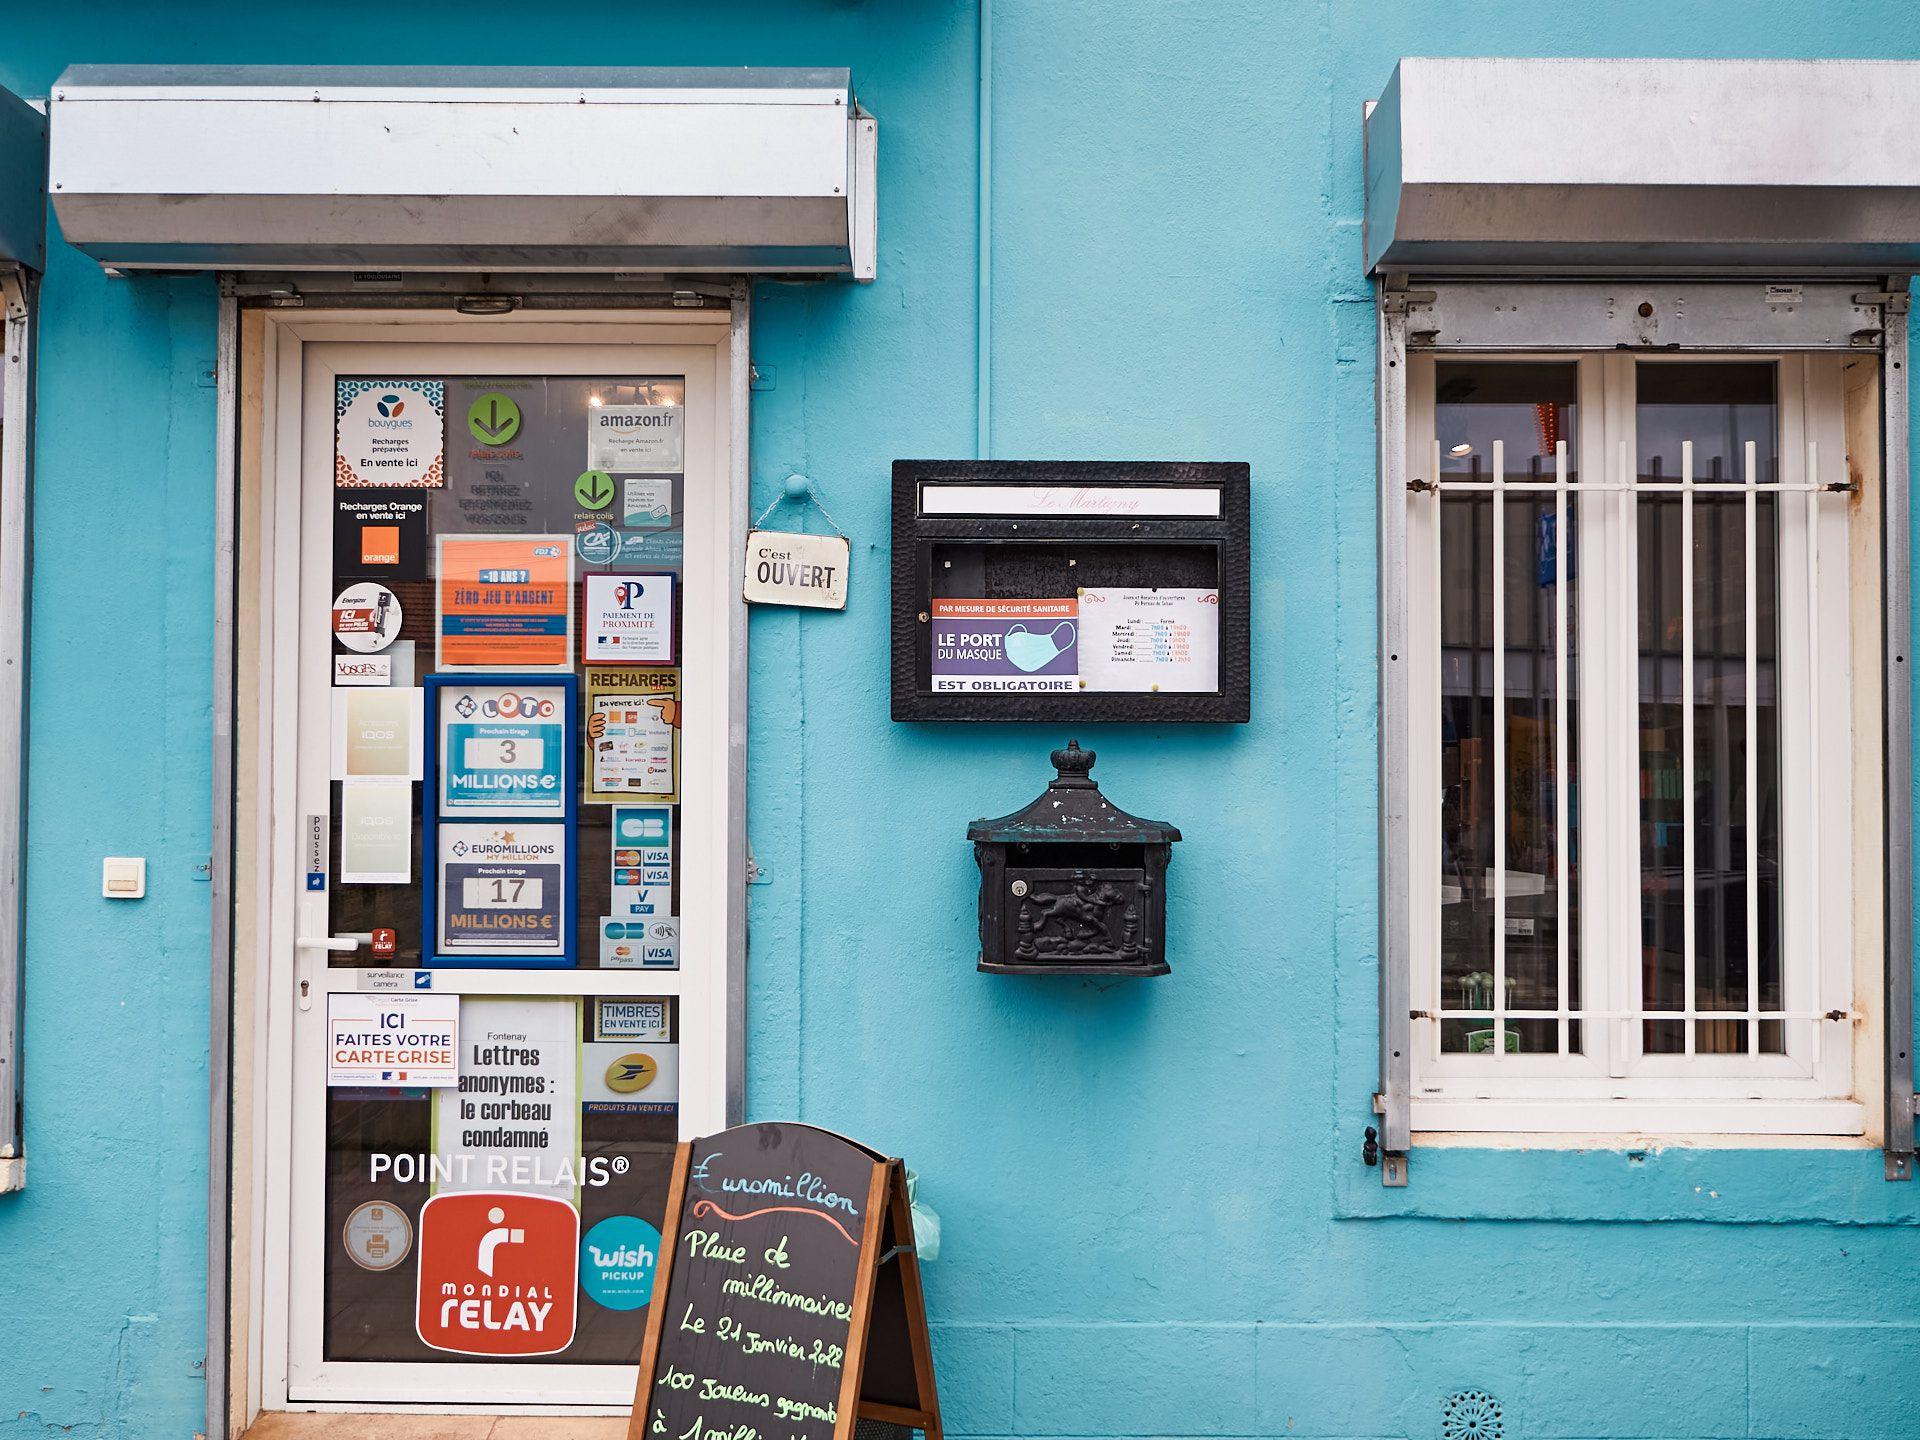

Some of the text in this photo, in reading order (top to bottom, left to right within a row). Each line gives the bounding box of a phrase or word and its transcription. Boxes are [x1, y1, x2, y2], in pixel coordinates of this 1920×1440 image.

[368, 418, 413, 430] bouygues
[600, 412, 674, 427] amazon.fr
[372, 438, 409, 446] Recharges
[608, 438, 634, 446] Recharge
[372, 446, 409, 454] prépayées
[360, 458, 418, 467] En vente ici
[340, 502, 422, 512] Recharges Orange
[369, 512, 394, 520] vente
[395, 512, 406, 520] ici
[574, 512, 614, 520] relais colis
[758, 547, 792, 561] C'est
[501, 571, 518, 582] ANS
[520, 571, 526, 582] ?
[757, 561, 836, 589] OUVERT
[454, 587, 555, 605] ZÉRO JEU D'ARGENT
[939, 603, 1070, 613] PAR MESURE DE SÉCURITÉ SANITAIRE
[340, 610, 356, 619] ICI
[602, 620, 656, 628] PROXIMITÉ
[938, 633, 1002, 647] LE PORT
[937, 649, 1002, 661] DU MASQUE
[591, 673, 677, 687] RECHARGES
[938, 680, 1073, 691] EST OBLIGATOIRE
[482, 692, 555, 718] LOTO
[510, 728, 529, 736] tirage
[500, 740, 516, 763] 3
[452, 774, 556, 789] MILLIONS €
[313, 816, 321, 872] poussez
[472, 844, 555, 854] EUROMILLIONS
[647, 852, 669, 861] VISA
[478, 867, 526, 876] Prochain tirage
[647, 871, 669, 880] VISA
[491, 879, 525, 903] 17
[635, 905, 650, 913] PAY
[451, 914, 537, 929] MILLIONS
[647, 948, 672, 958] VISA
[367, 970, 405, 979] surveillance
[604, 1005, 660, 1018] TIMBRES
[380, 1013, 405, 1029] ICI
[604, 1019, 660, 1028] EN VENTE ICI
[336, 1034, 451, 1046] FAITES VOTRE
[487, 1031, 527, 1042] Fontenay
[335, 1050, 451, 1064] CARTE GRISE
[473, 1044, 540, 1066] Lettres
[458, 1075, 545, 1096] anonymes
[460, 1099, 551, 1121] le corbeau
[588, 1104, 674, 1112] PRODUITS EN VENTE ICI
[462, 1126, 549, 1148] condamné
[370, 1153, 476, 1184] POINT
[684, 1230, 791, 1269] Pluie de
[588, 1244, 654, 1268] wish
[602, 1271, 645, 1281] PICKUP
[680, 1302, 706, 1334] Le
[716, 1316, 742, 1342] 21
[658, 1364, 695, 1390] 100
[652, 1408, 668, 1434] à
